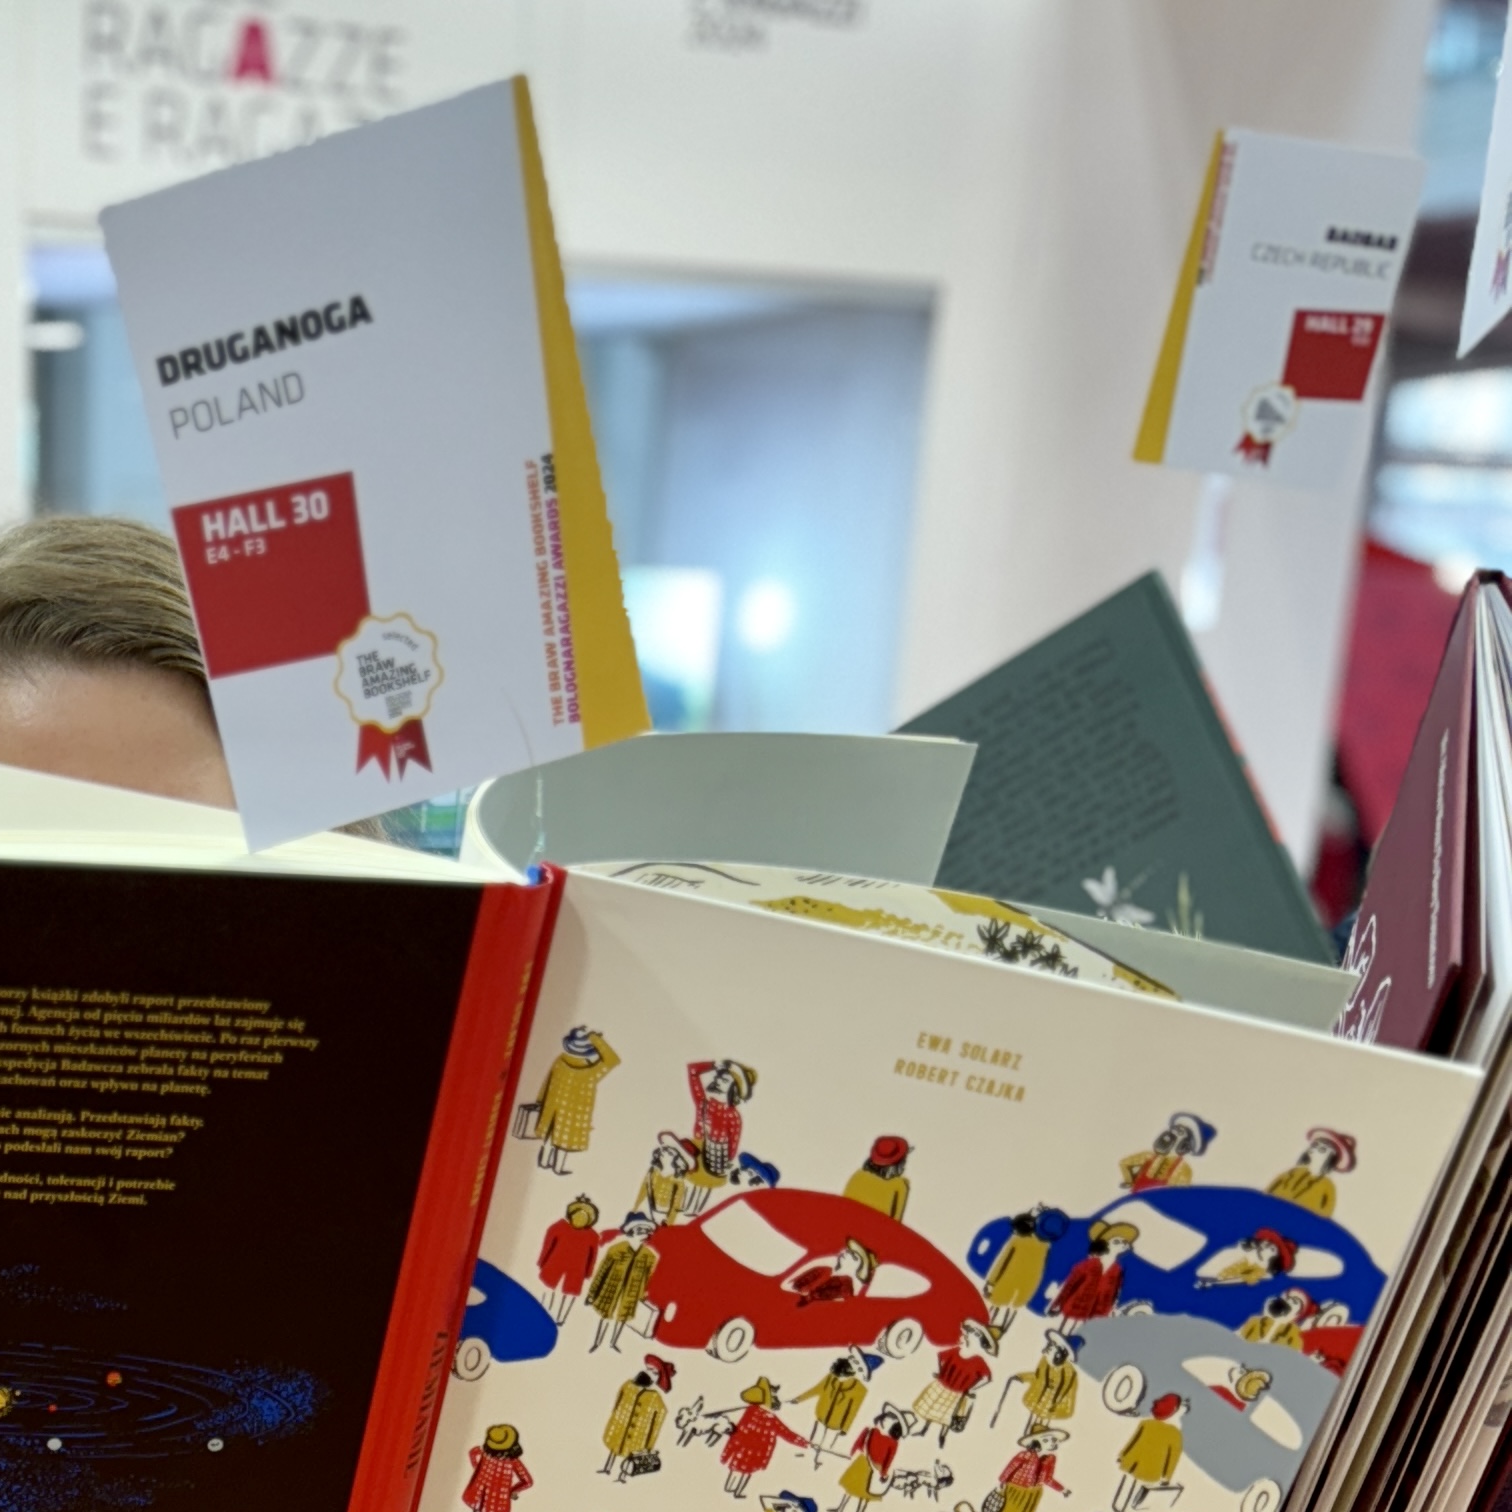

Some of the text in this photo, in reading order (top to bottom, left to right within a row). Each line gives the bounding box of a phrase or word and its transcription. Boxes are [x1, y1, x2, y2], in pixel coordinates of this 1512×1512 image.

[1309, 250, 1393, 280] REPUBLIC
[155, 294, 373, 387] DRUGANOGA
[1304, 315, 1348, 335] HALL
[169, 371, 306, 440] POLAND
[202, 491, 329, 542] HALL 30
[205, 544, 230, 565] E4
[244, 539, 265, 557] F3
[525, 459, 564, 727] THE BRAW AMAZING BOOKSHELF
[541, 453, 581, 724] BOLOGNARAGAZZI AWARDS 2024
[356, 650, 379, 666] THE
[358, 657, 395, 678] BRAW
[362, 662, 418, 688] AMAZING
[363, 670, 431, 699] BOOKSHELF
[916, 1031, 1023, 1071] EWA SOLARZ
[894, 1058, 1025, 1102] ROBERT CZAJKA
